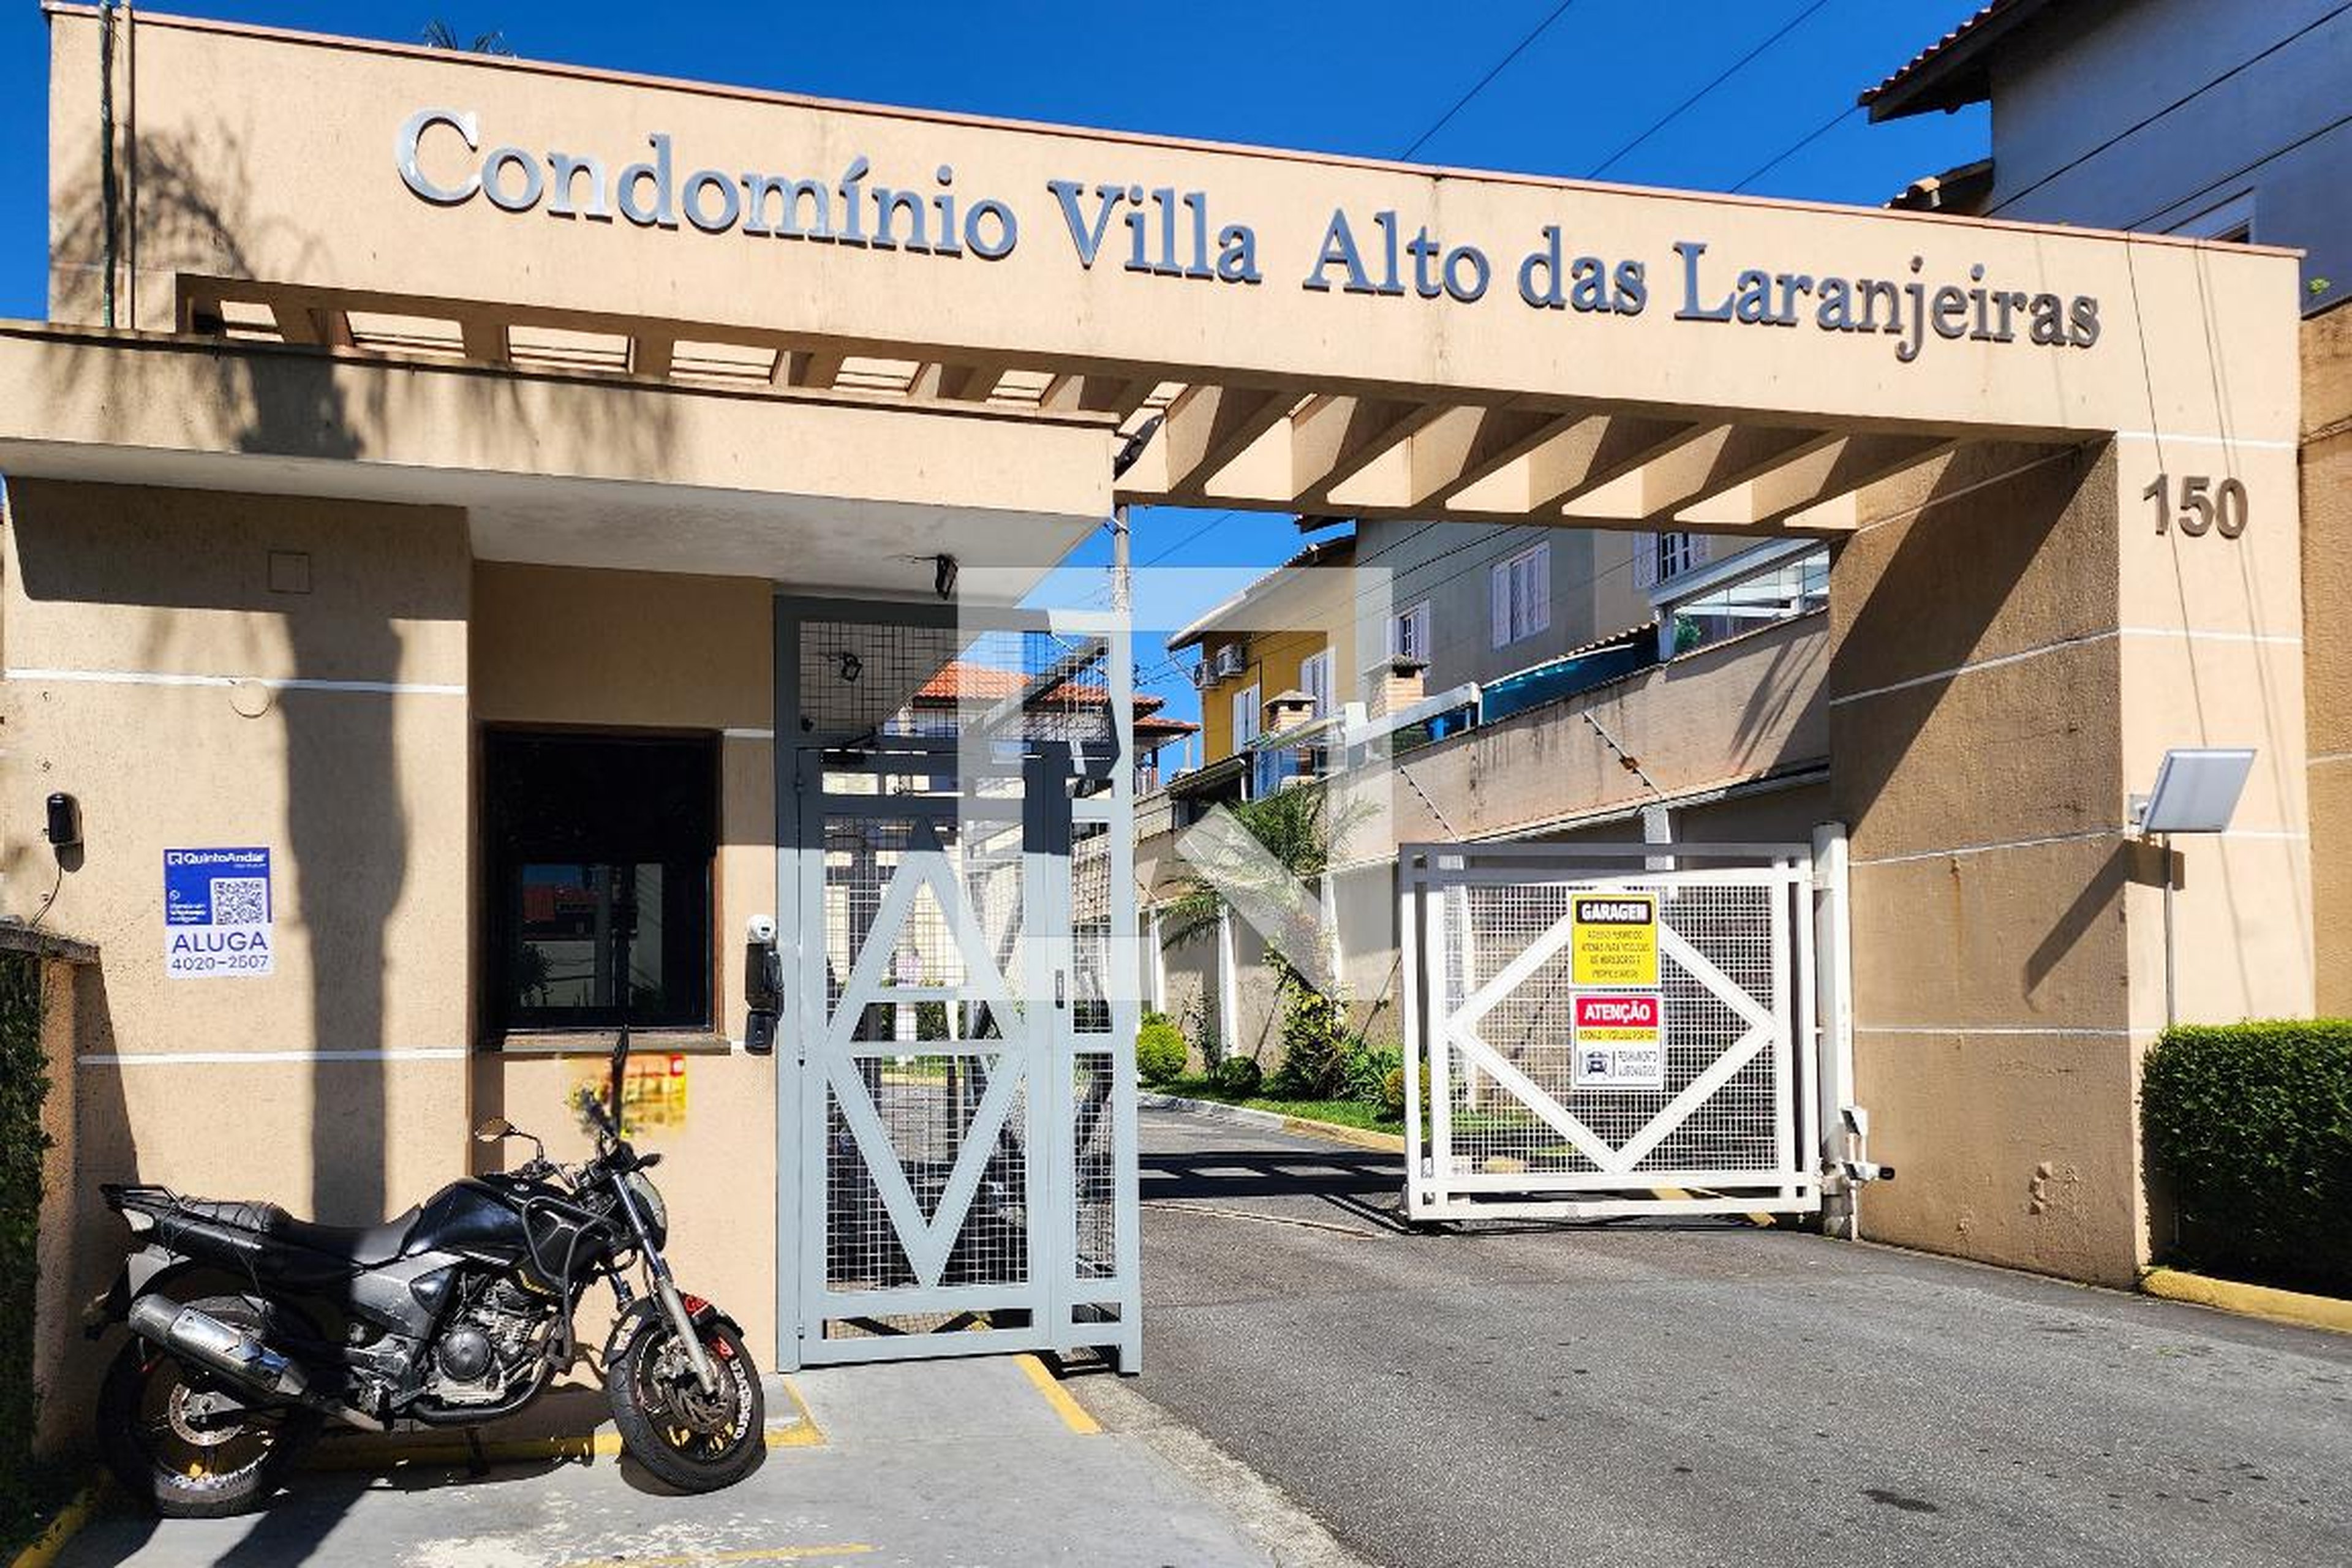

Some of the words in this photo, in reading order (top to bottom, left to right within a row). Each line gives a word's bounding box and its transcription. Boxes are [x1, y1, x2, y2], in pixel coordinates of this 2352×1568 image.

[395, 107, 1017, 261] Condomínio
[1047, 179, 1263, 284] Villa
[1303, 207, 1491, 303] Alto
[1516, 225, 1648, 316] das
[1673, 241, 2101, 363] Laranjeiras
[2143, 473, 2248, 540] 150
[172, 931, 268, 954] ALUGA
[1584, 1000, 1650, 1023] ATENÇÃO
